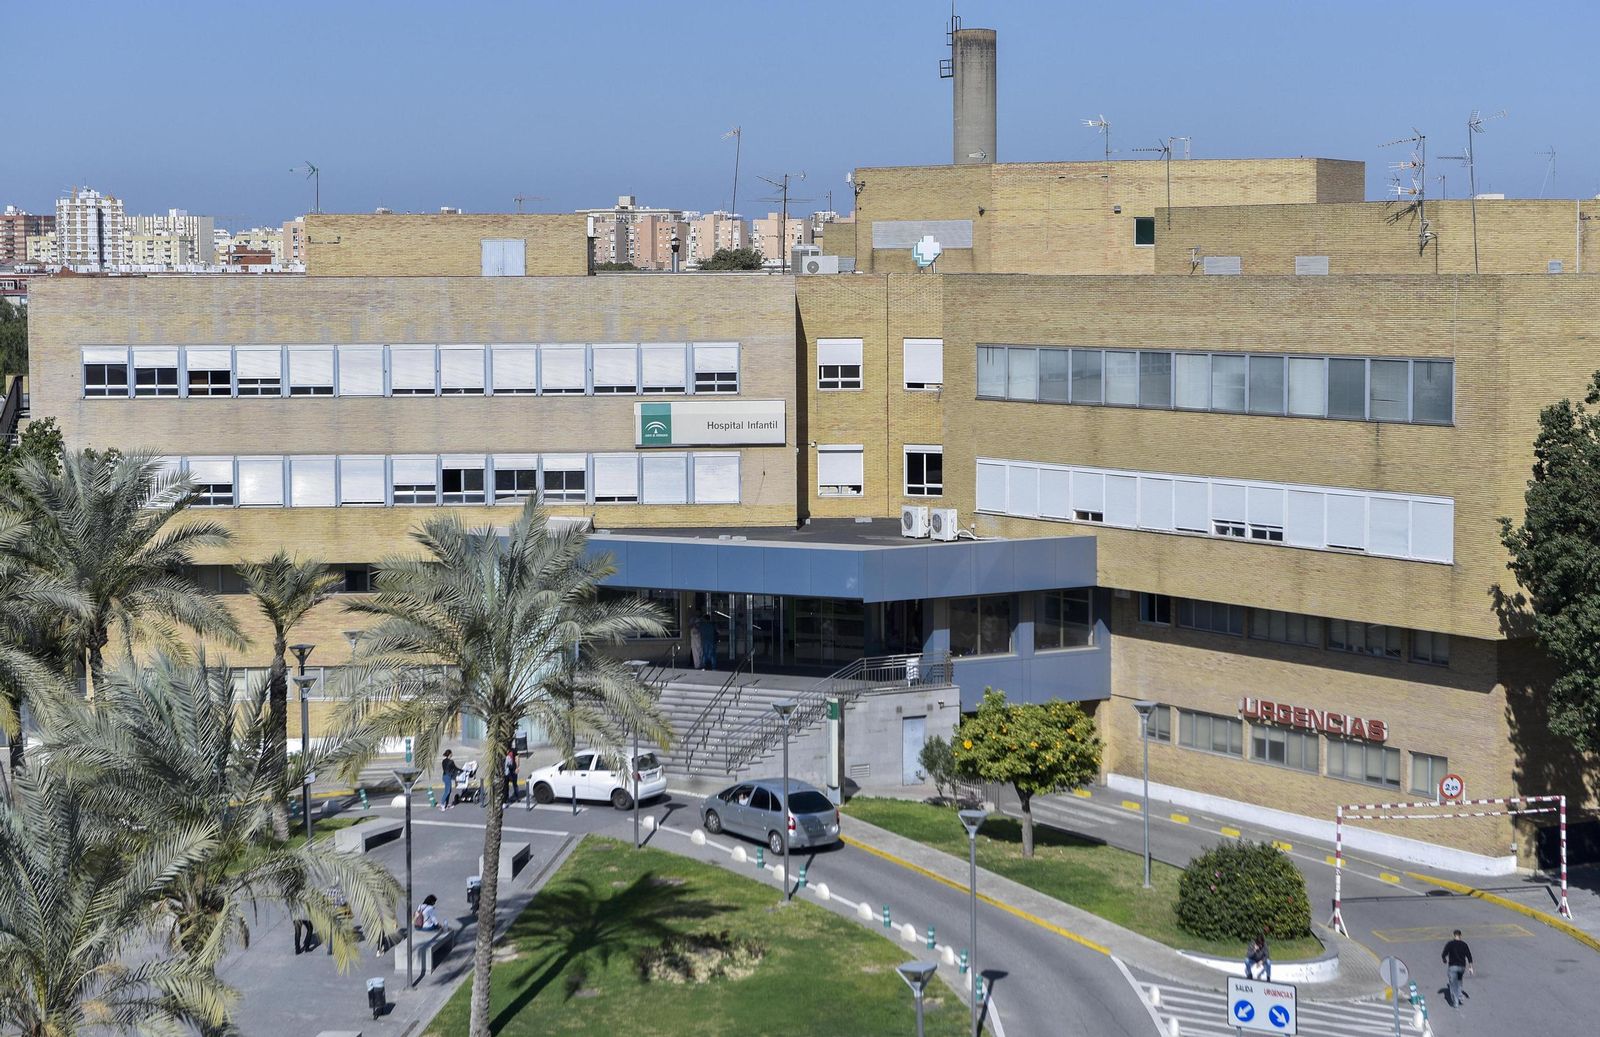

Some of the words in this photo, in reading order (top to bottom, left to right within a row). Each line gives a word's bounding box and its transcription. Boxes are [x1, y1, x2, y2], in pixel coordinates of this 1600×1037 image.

[707, 421, 744, 431] Hospital
[748, 420, 778, 430] Infantil
[1239, 697, 1388, 742] URGENCIAS
